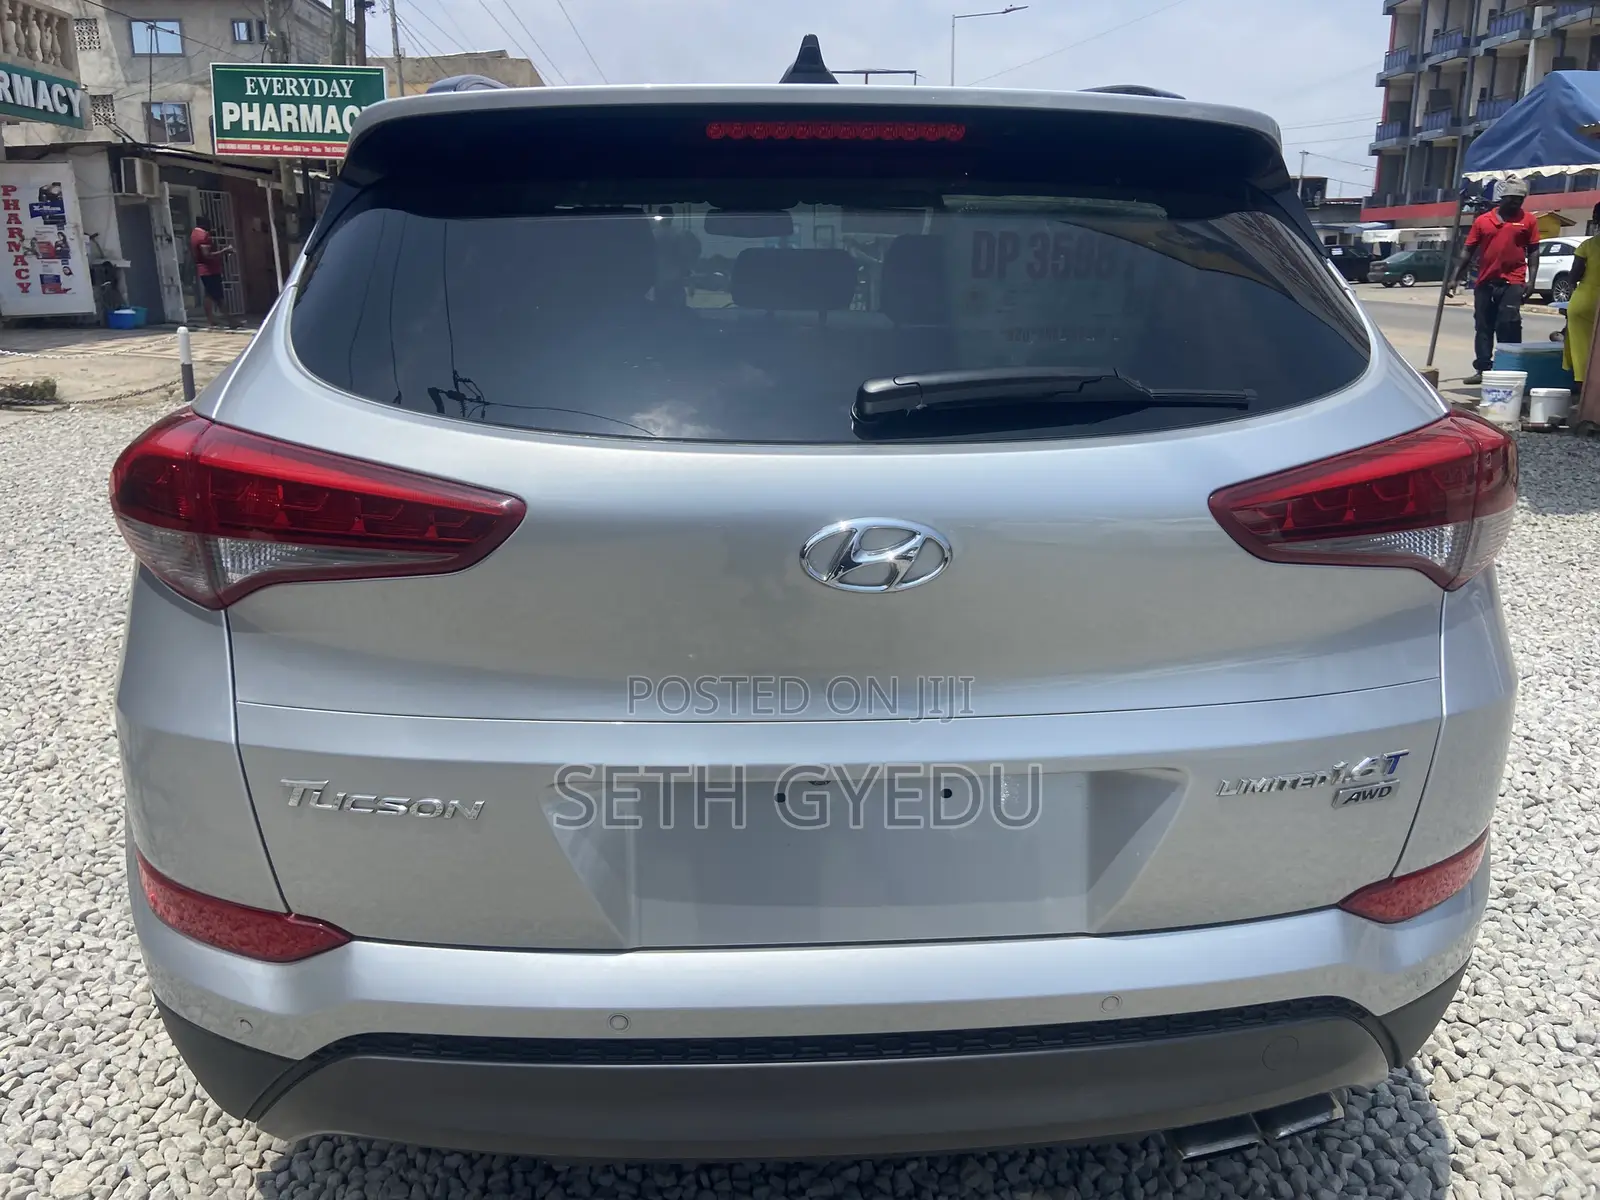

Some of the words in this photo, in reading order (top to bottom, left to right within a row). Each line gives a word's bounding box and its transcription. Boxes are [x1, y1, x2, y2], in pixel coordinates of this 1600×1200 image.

[244, 76, 354, 98] EVERYDAY
[221, 101, 370, 134] PHARMAC
[971, 230, 1020, 279] DP
[1216, 770, 1328, 797] LIMITED
[1341, 785, 1393, 806] AWD
[280, 778, 485, 821] TUCSON
